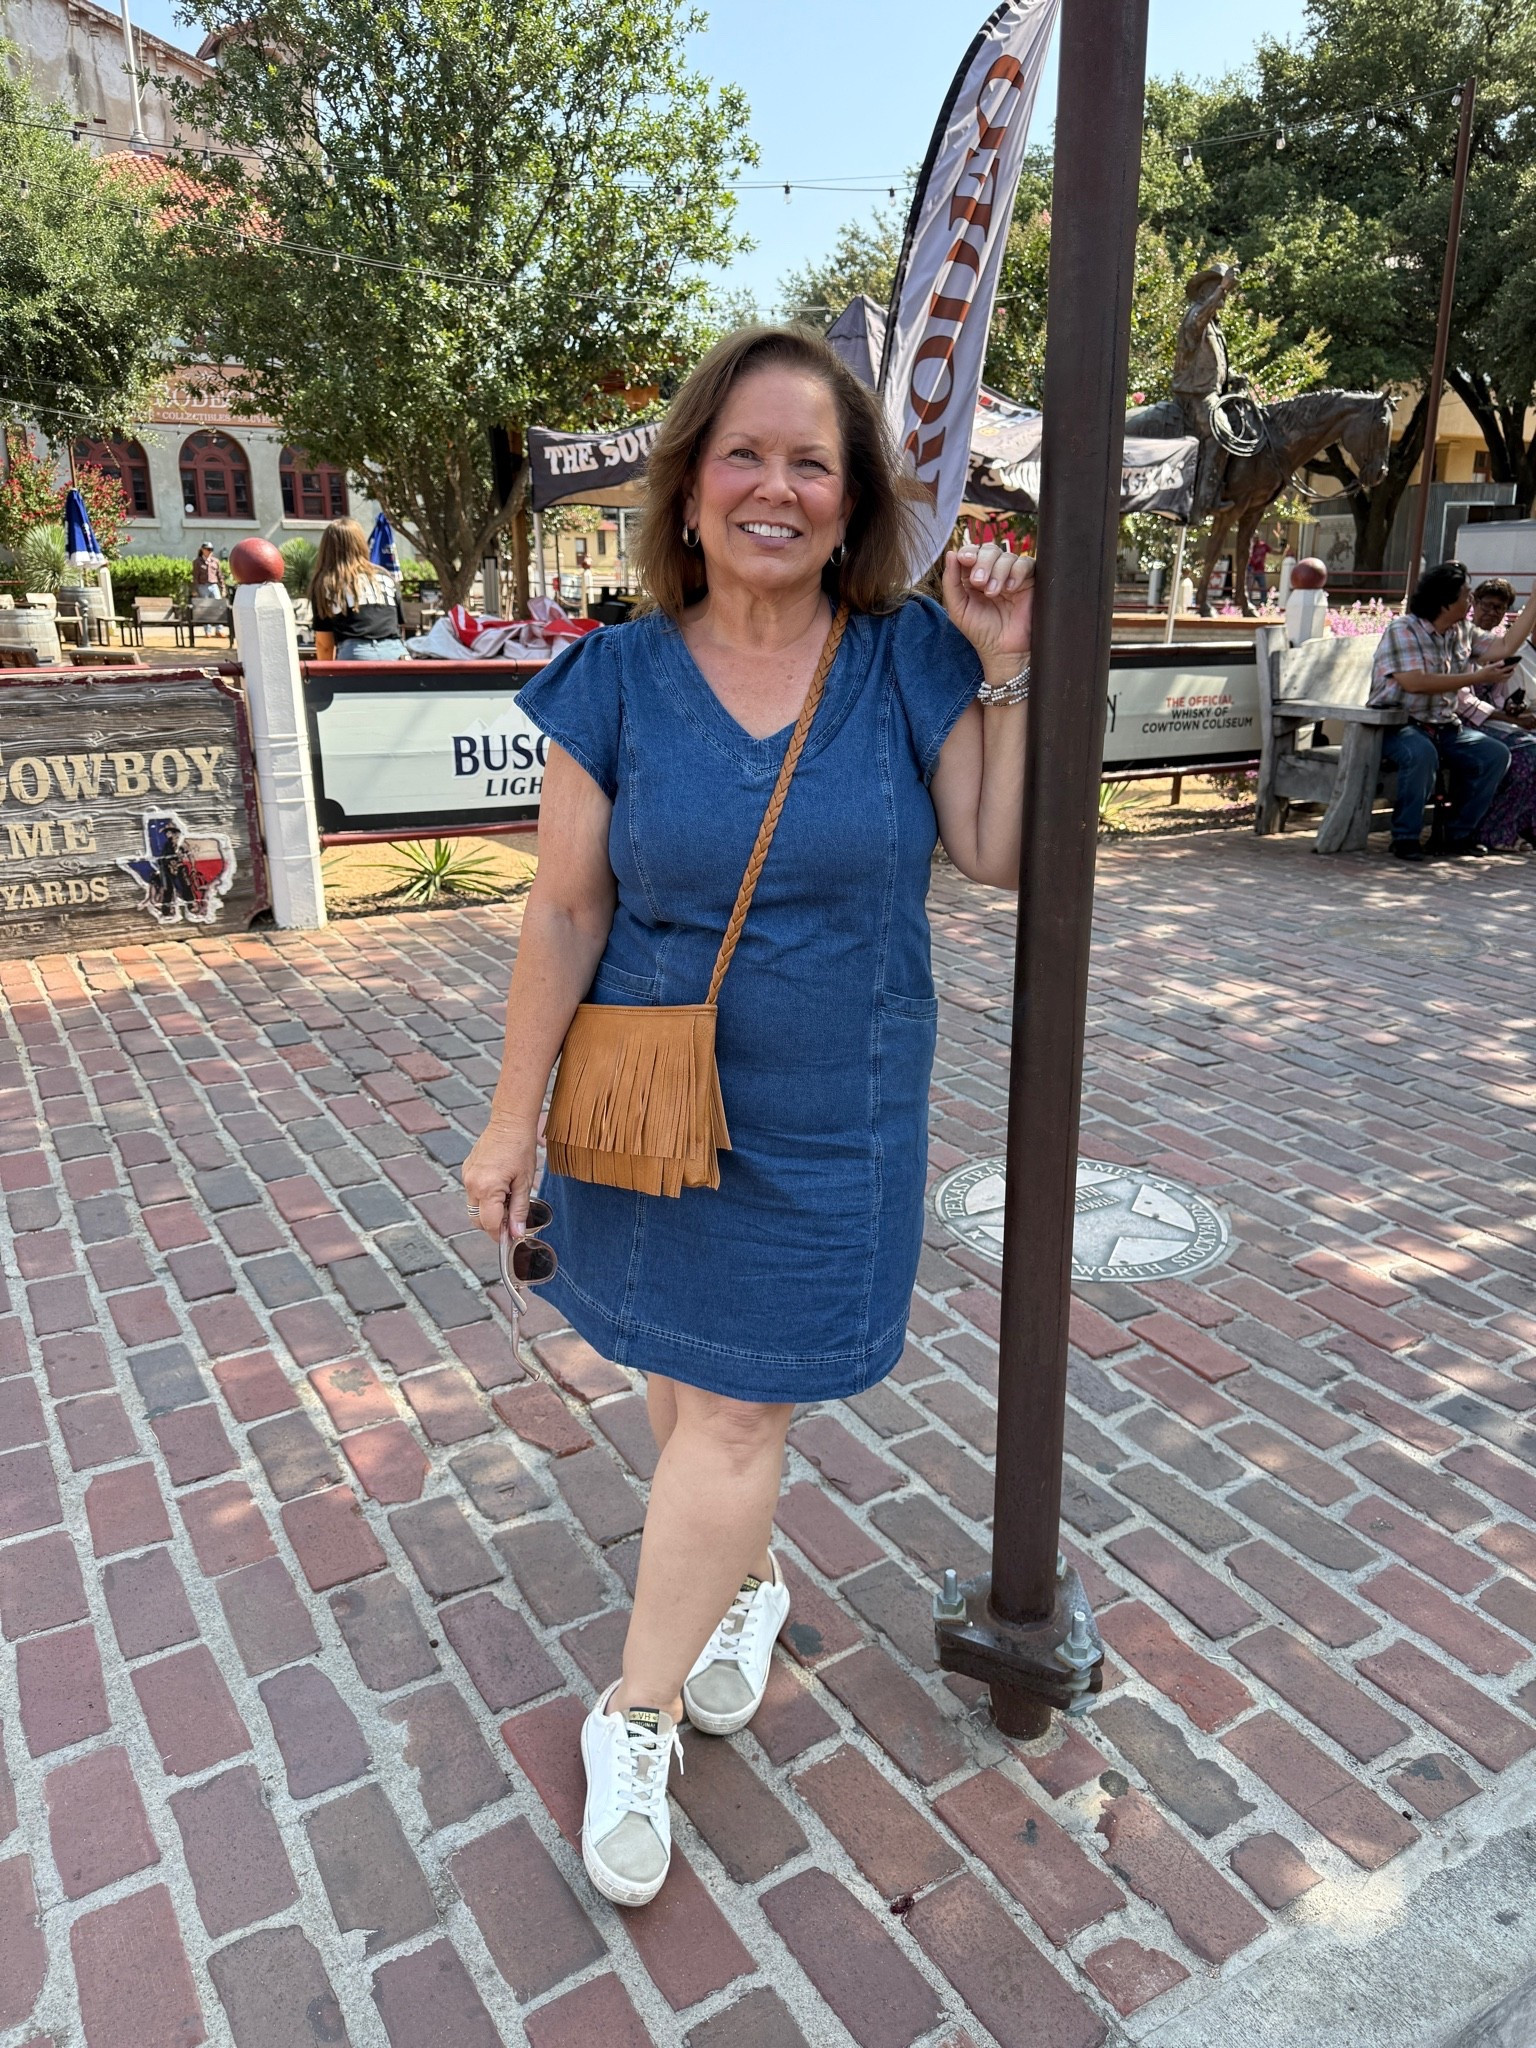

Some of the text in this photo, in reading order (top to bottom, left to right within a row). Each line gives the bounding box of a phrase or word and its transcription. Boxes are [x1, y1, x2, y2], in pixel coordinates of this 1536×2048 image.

[162, 411, 231, 422] COLLECTIBLES
[543, 442, 599, 475] THE
[1165, 694, 1235, 708] THE OFFICIAL
[1171, 706, 1229, 720] WHISKY OF
[1142, 717, 1253, 734] COWTOWN COLISEUM
[0, 746, 224, 805] OWBOY
[944, 1180, 971, 1218] TEXAS
[1074, 1203, 1217, 1277] WORTH STOCKYARDS
[638, 1712, 651, 1721] VH
